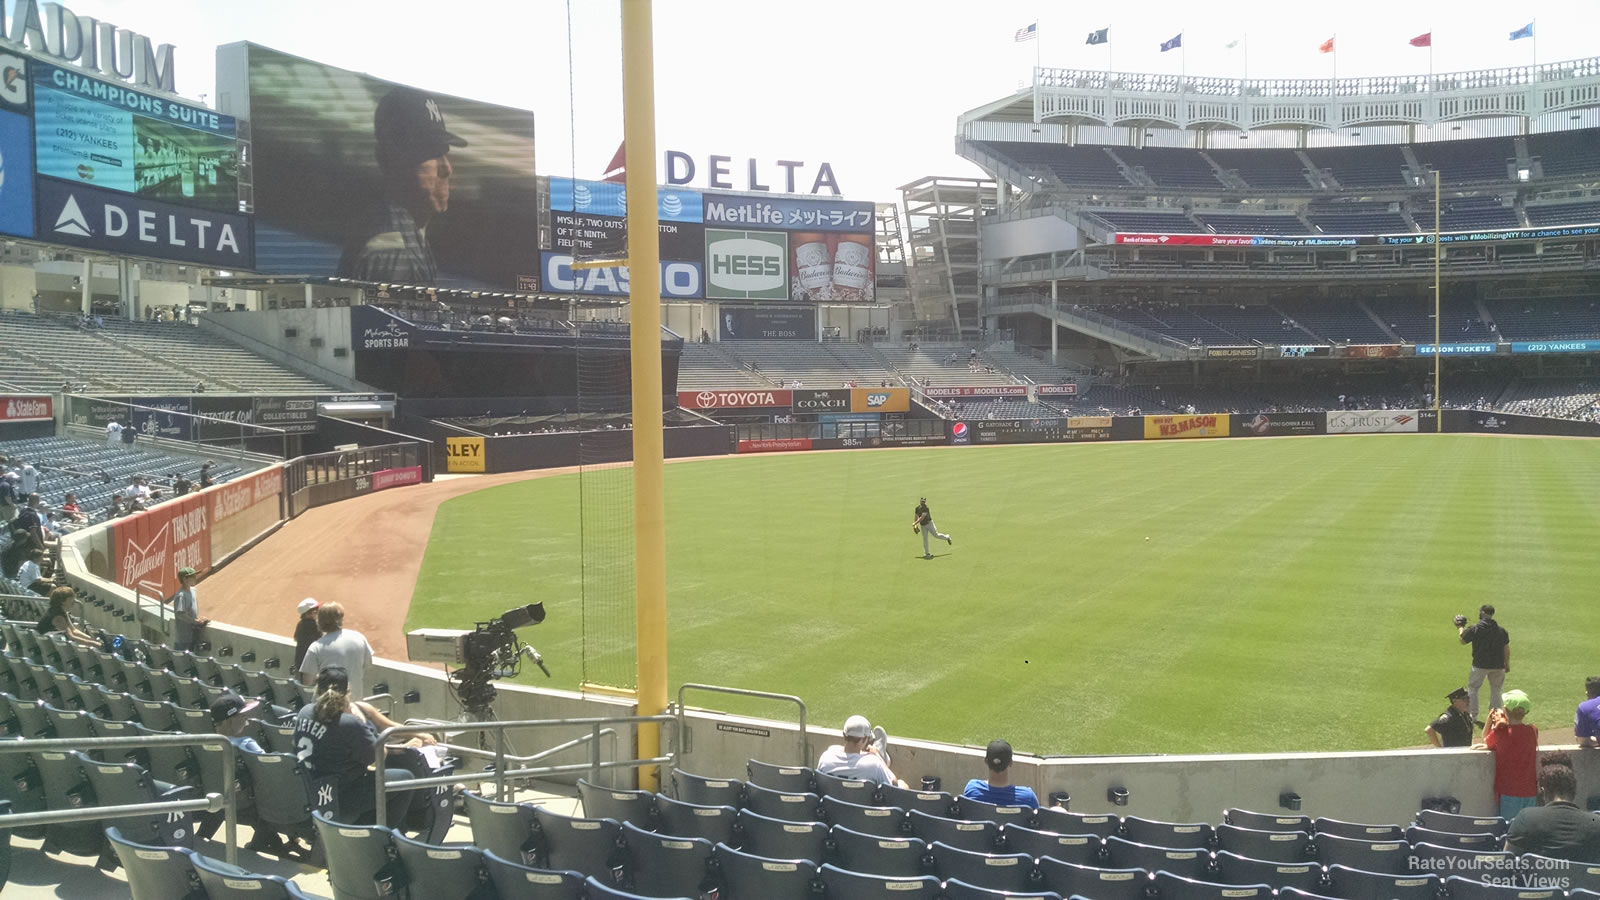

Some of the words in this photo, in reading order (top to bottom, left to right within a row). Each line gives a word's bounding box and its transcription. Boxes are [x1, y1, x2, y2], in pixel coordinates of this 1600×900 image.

[0, 0, 178, 94] ADIUM
[52, 69, 163, 115] CHAMPIONS
[168, 104, 220, 130] SUITE
[55, 127, 78, 142] (212)
[78, 132, 119, 151] YANKEES
[664, 149, 842, 195] DELTA
[706, 201, 784, 225] MetLife
[788, 208, 872, 227] メットライフ
[103, 203, 240, 254] DELTA
[586, 218, 603, 228] TWO
[604, 220, 622, 229] OUTS
[557, 227, 567, 235] OF
[568, 228, 583, 237] TE
[1454, 233, 1469, 241] with
[1536, 230, 1561, 238] chance
[1211, 237, 1226, 245] Share
[713, 254, 781, 277] HESS
[762, 330, 777, 338] THE
[778, 330, 797, 338] BOSS
[364, 338, 392, 349] SPORTS
[393, 338, 409, 348] BAR
[1455, 345, 1491, 353] TICKETS
[1527, 344, 1547, 352] (212)
[1548, 342, 1587, 351] YANKEES
[719, 391, 775, 407] TOYOTA
[797, 399, 847, 409] COACH
[867, 395, 888, 406] SAP
[773, 414, 797, 424] FedEx
[1330, 418, 1349, 428] U.S.
[1350, 416, 1390, 428] TRUST
[172, 513, 188, 545] THIS
